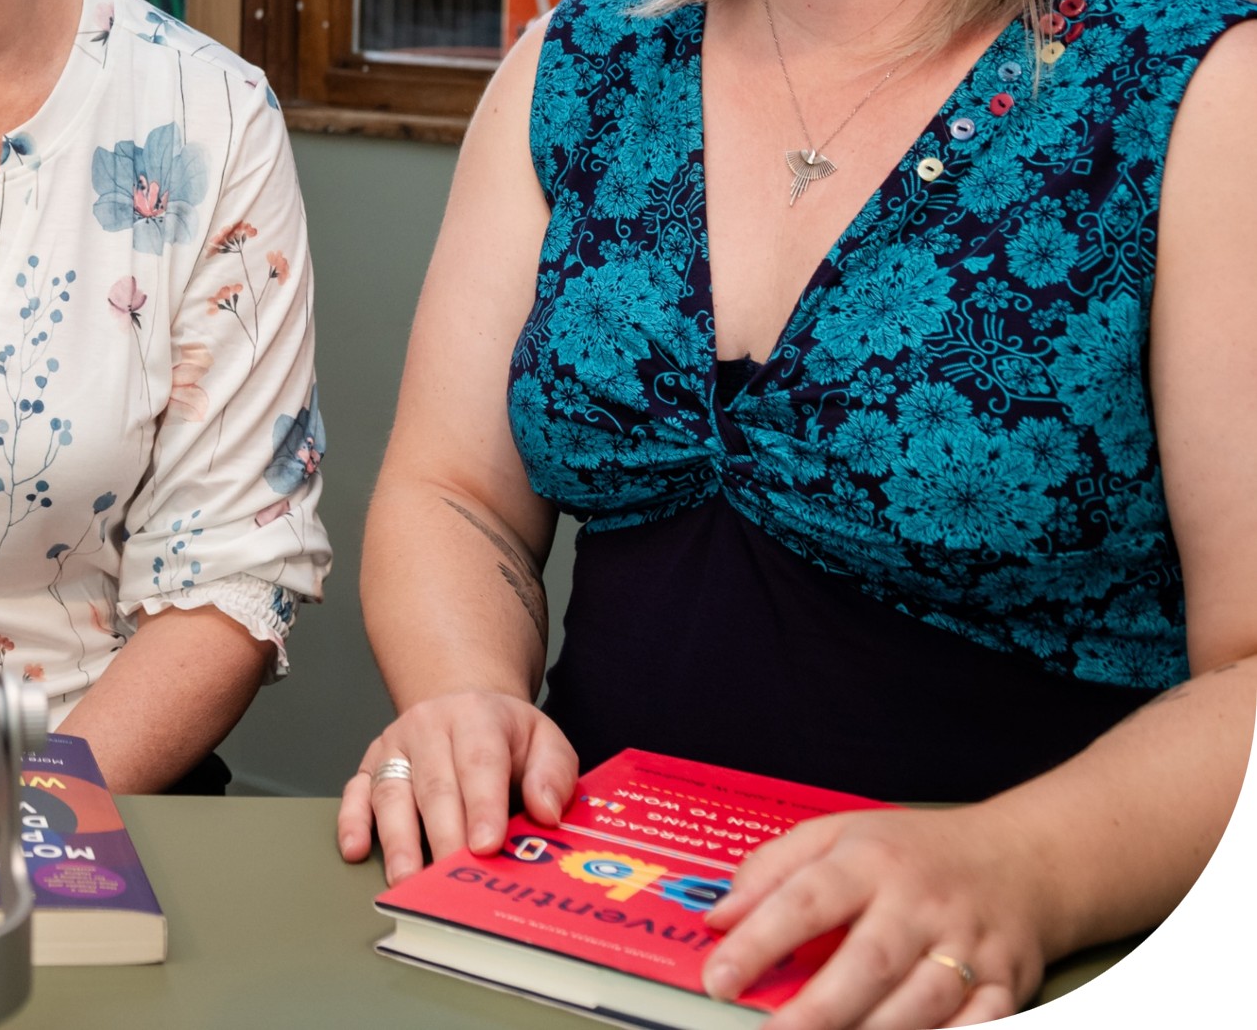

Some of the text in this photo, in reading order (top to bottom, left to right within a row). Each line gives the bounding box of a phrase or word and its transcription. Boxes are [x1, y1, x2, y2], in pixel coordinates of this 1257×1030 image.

[614, 788, 719, 821] TO WORK
[595, 814, 723, 850] APPROACH
[647, 811, 761, 844] APPLYING
[446, 866, 717, 953] inventing
